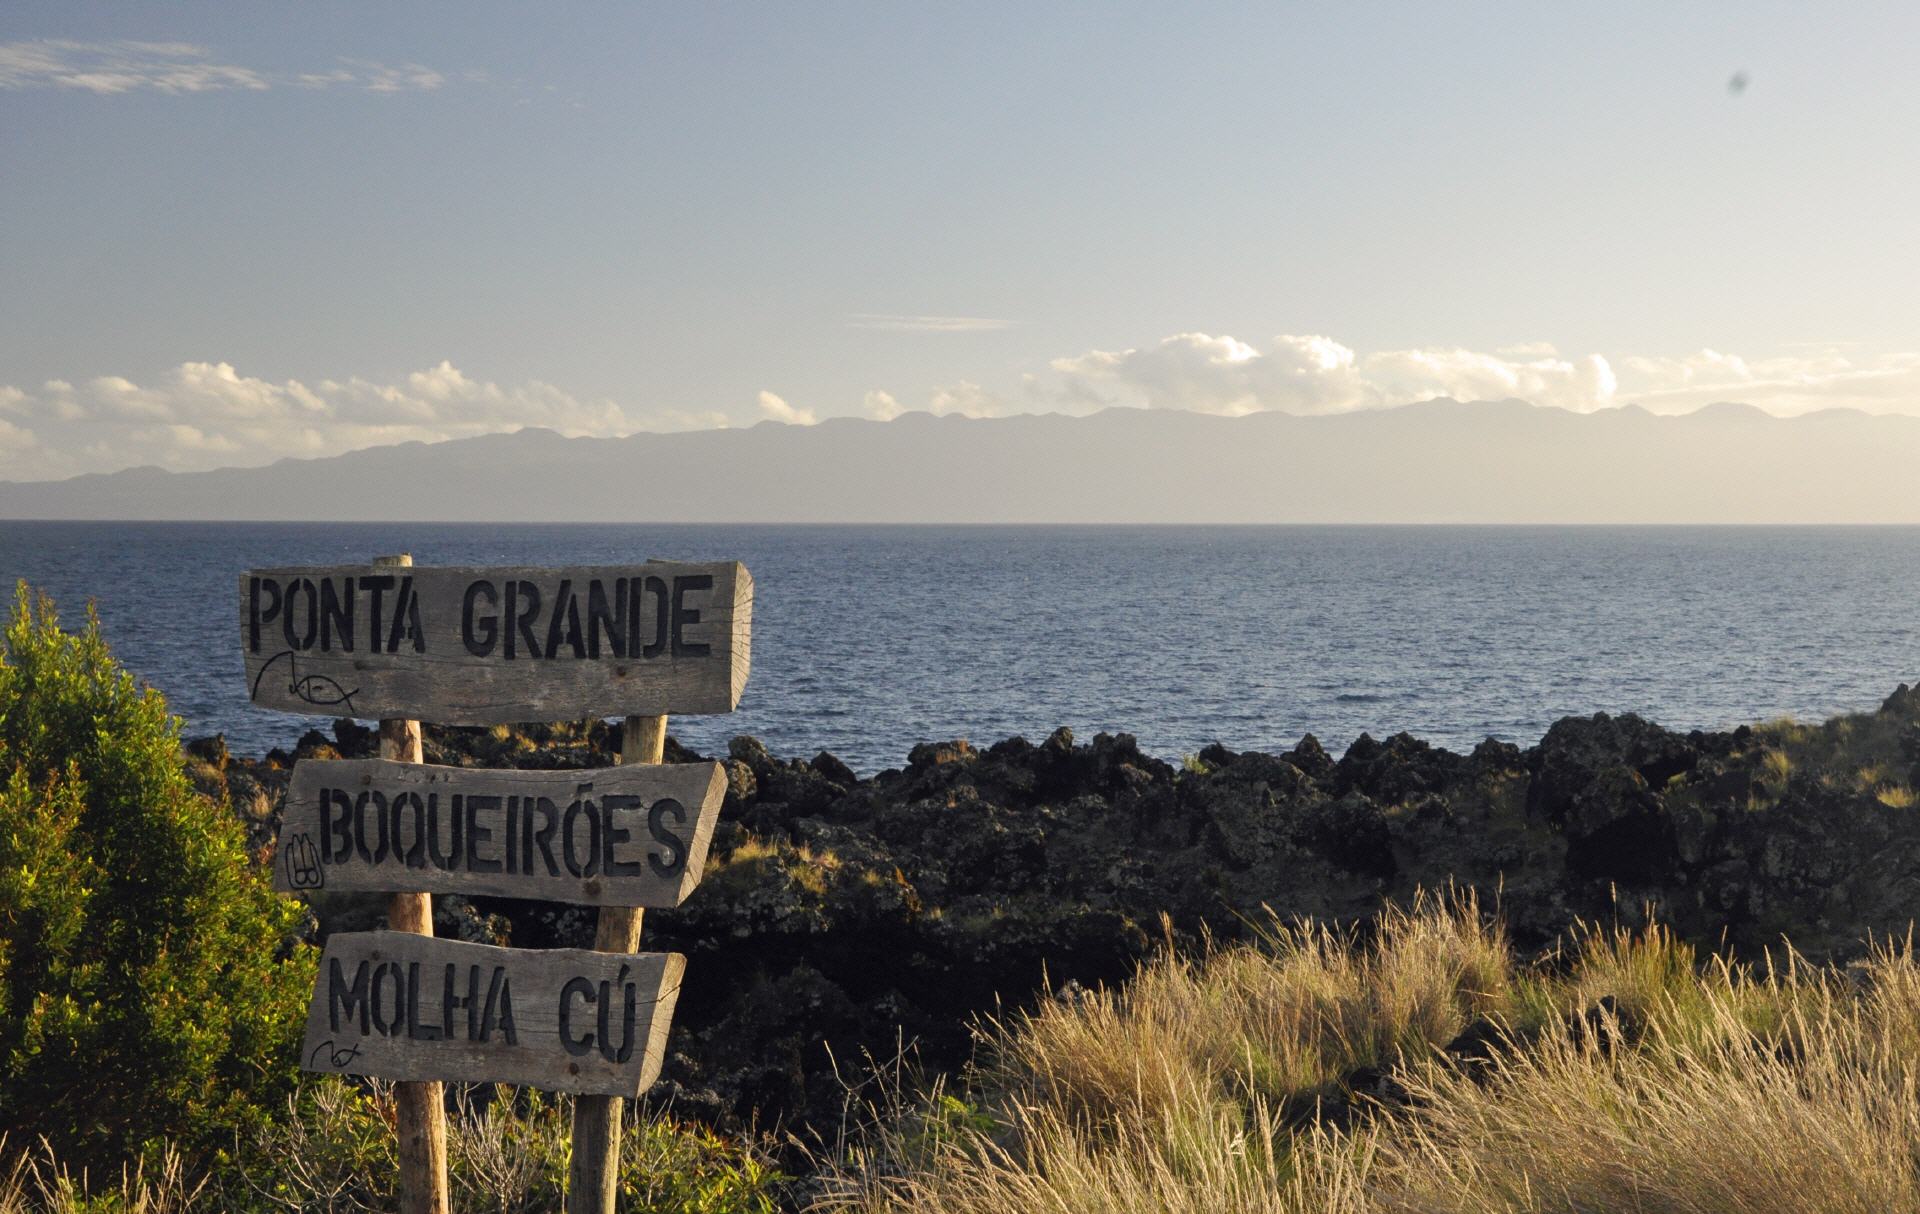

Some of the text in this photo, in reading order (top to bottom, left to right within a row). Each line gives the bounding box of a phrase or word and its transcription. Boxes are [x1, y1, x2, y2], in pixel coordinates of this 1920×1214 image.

[249, 574, 713, 660] PONTA GRANDE
[329, 957, 637, 1064] MOLHA CÚ
